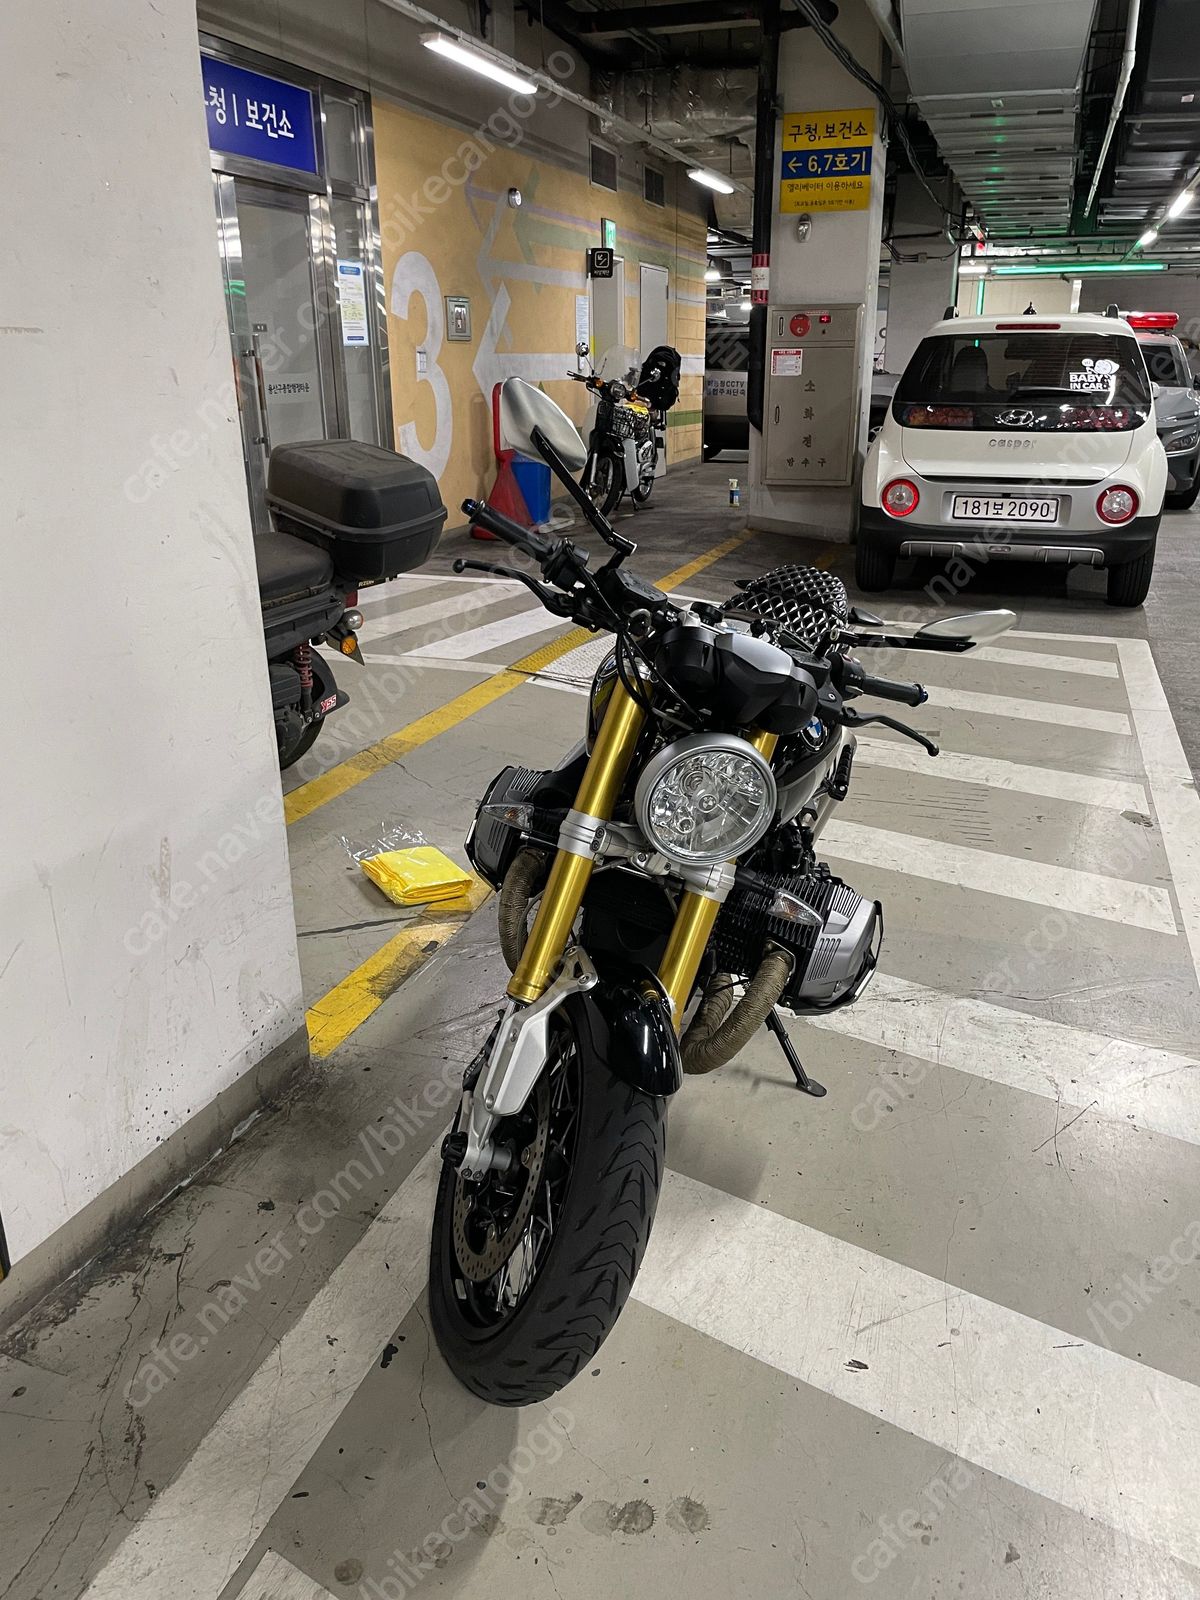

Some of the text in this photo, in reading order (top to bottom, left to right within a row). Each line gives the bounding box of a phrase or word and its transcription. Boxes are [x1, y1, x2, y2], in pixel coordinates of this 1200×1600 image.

[204, 86, 295, 139] 청 보건소
[807, 150, 866, 175] 6,7호기
[826, 180, 864, 192] 이용하세요
[390, 252, 454, 482] 3
[1070, 374, 1103, 383] BABY
[1070, 382, 1103, 390] IN CAR
